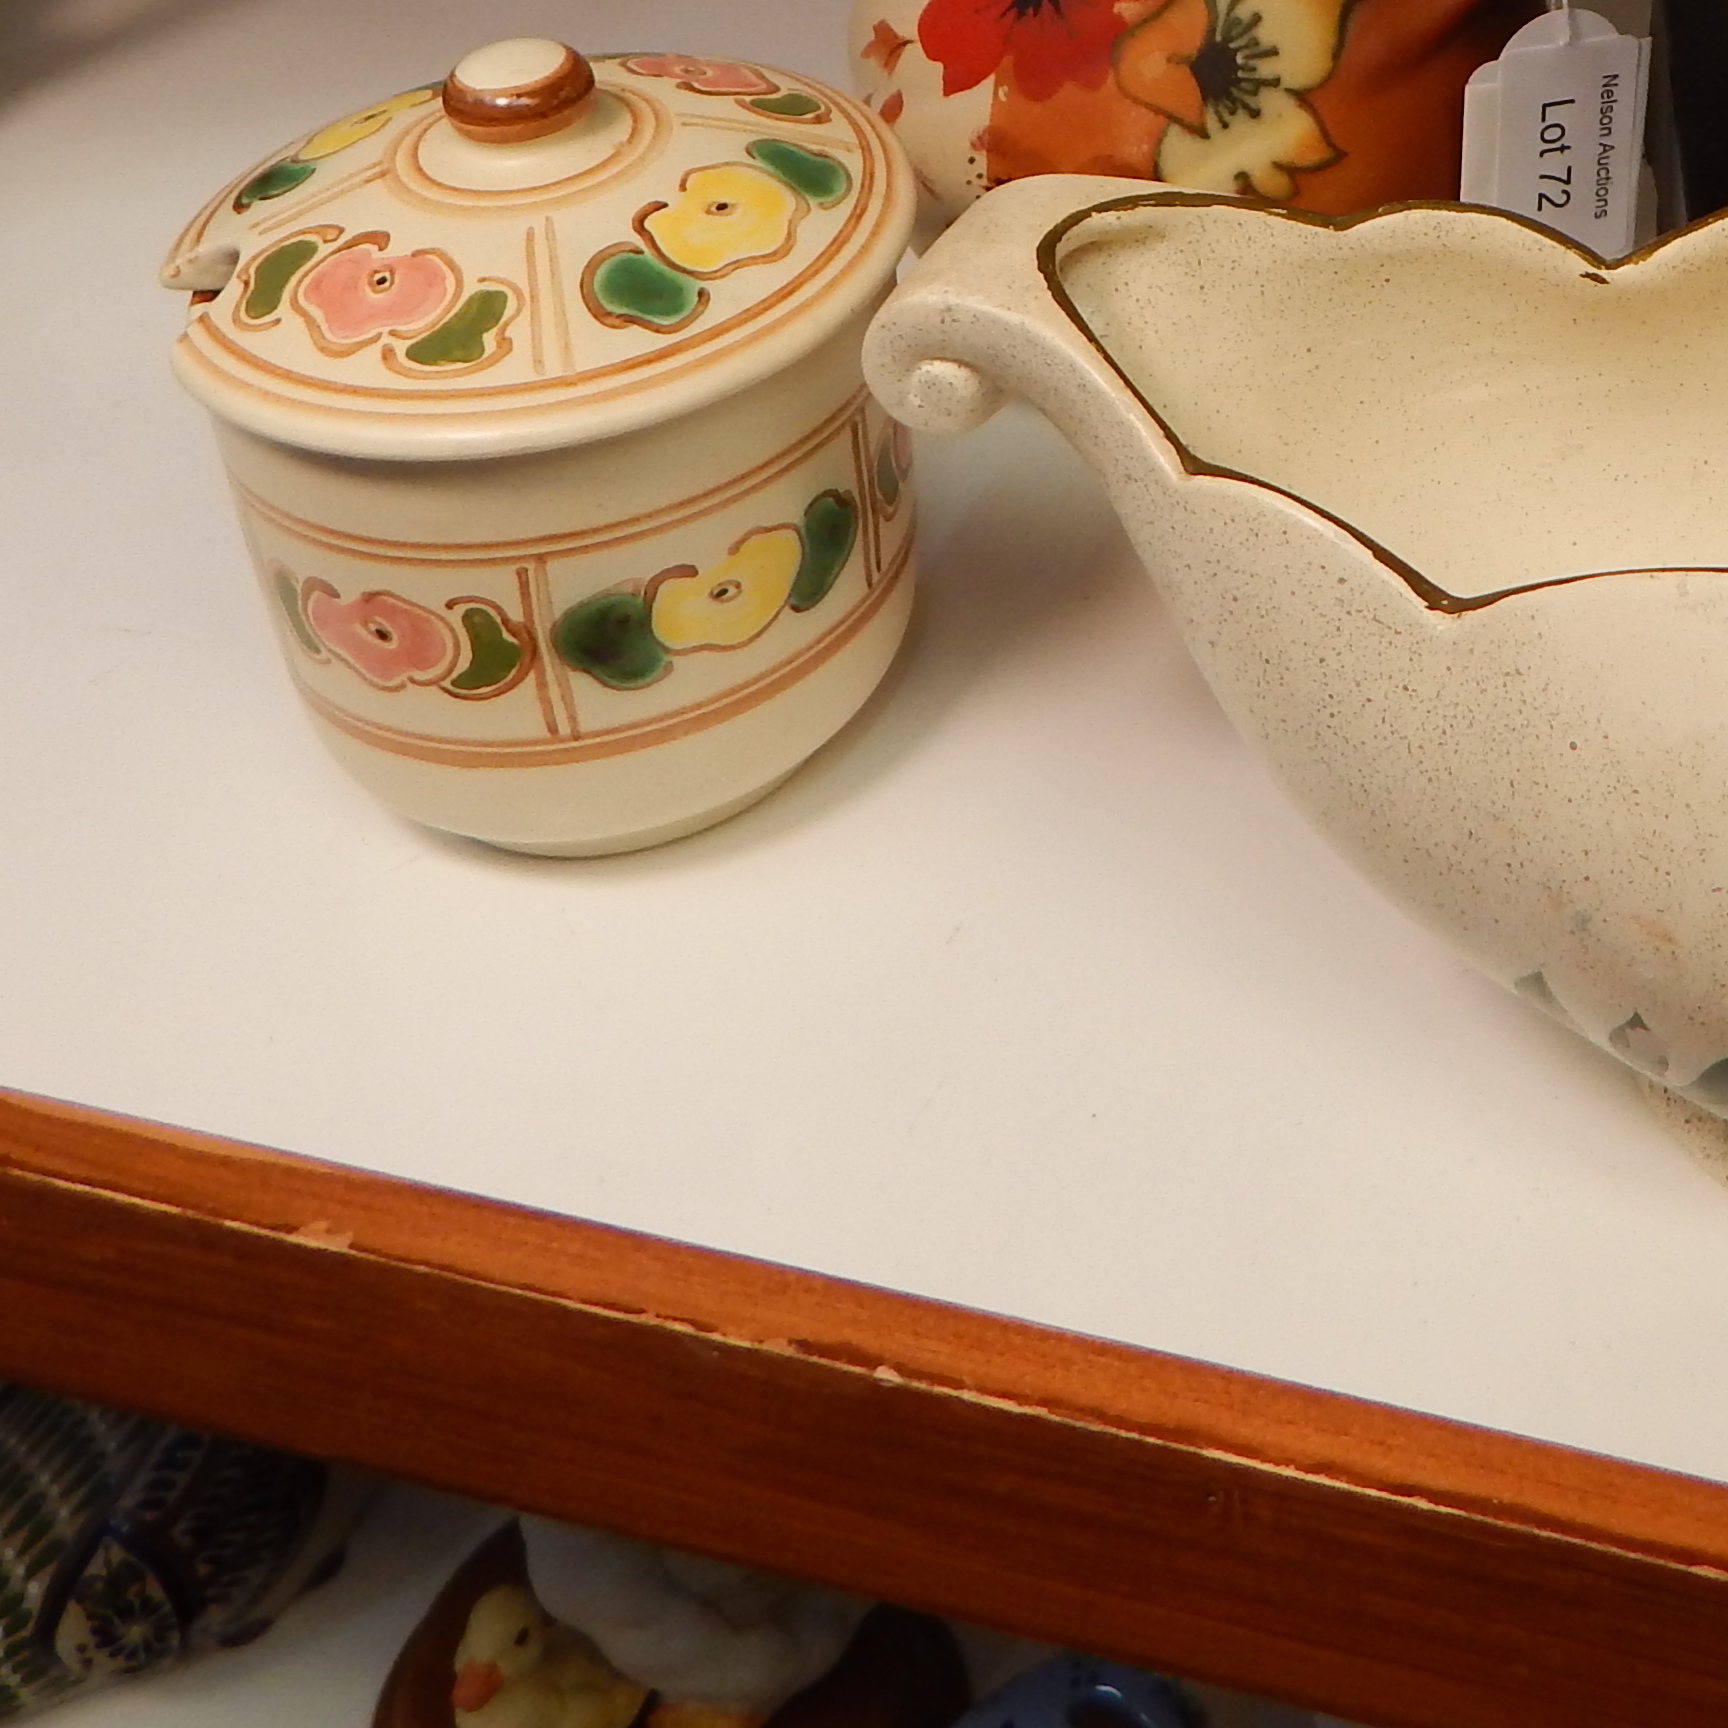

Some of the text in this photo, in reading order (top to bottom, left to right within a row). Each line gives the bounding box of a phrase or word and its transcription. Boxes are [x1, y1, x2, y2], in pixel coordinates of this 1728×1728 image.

[1536, 98, 1576, 212] Lot 72
[1593, 74, 1620, 220] Nelson Auctions
